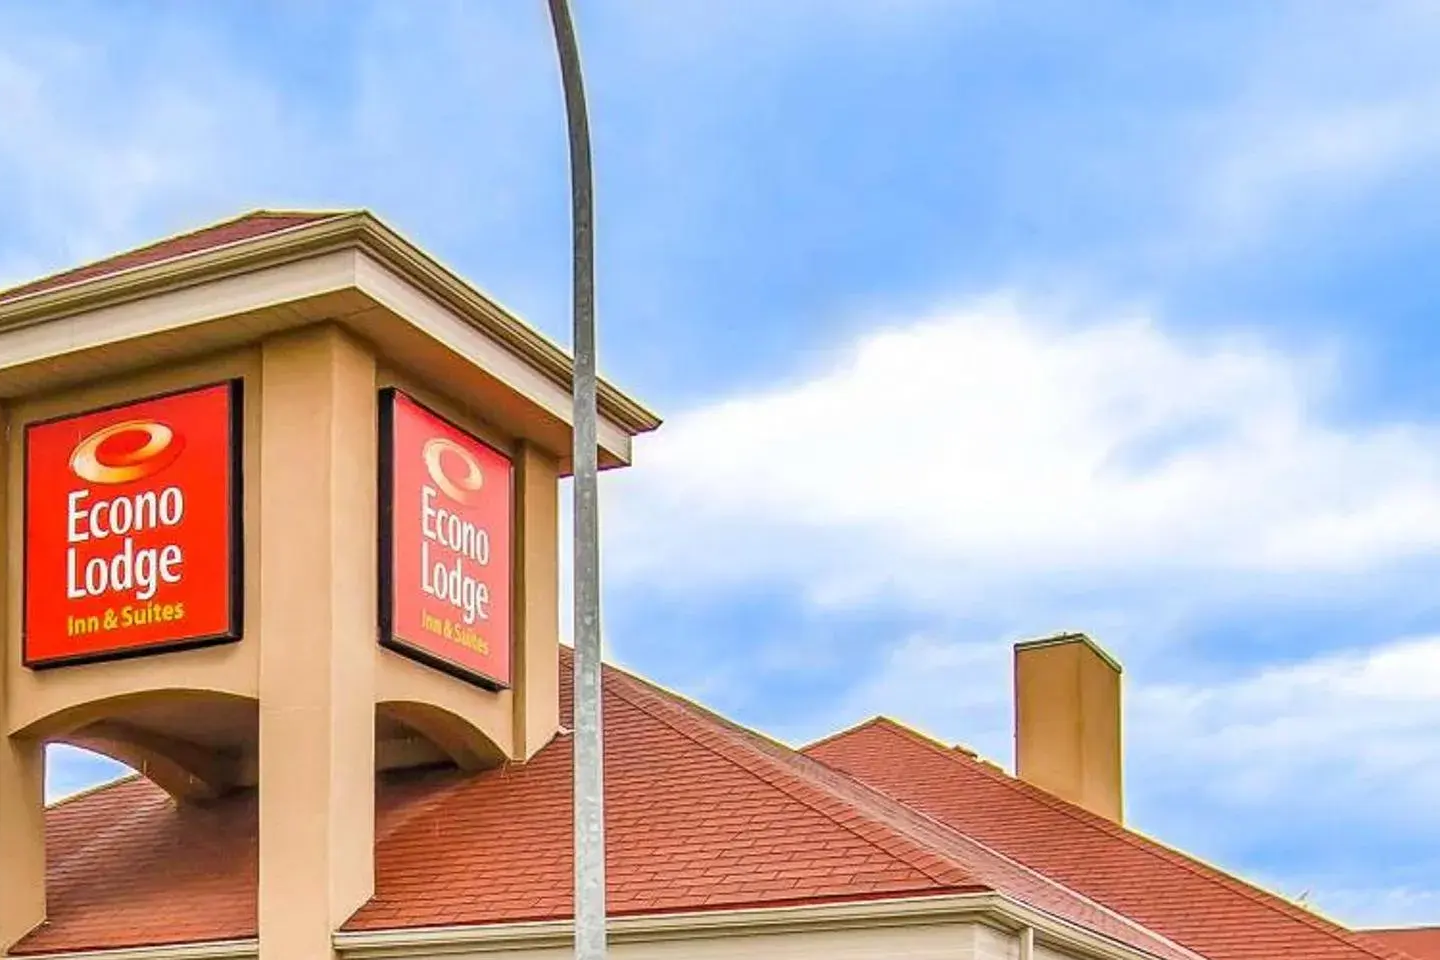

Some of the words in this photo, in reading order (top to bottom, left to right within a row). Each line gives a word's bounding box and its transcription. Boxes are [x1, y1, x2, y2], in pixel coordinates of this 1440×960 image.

[67, 486, 185, 543] Econo
[421, 486, 490, 566] Econo
[67, 538, 182, 600] Lodge
[421, 541, 489, 625] Lodge
[67, 612, 99, 636] Inn
[103, 608, 118, 630] &
[121, 600, 185, 627] Suites
